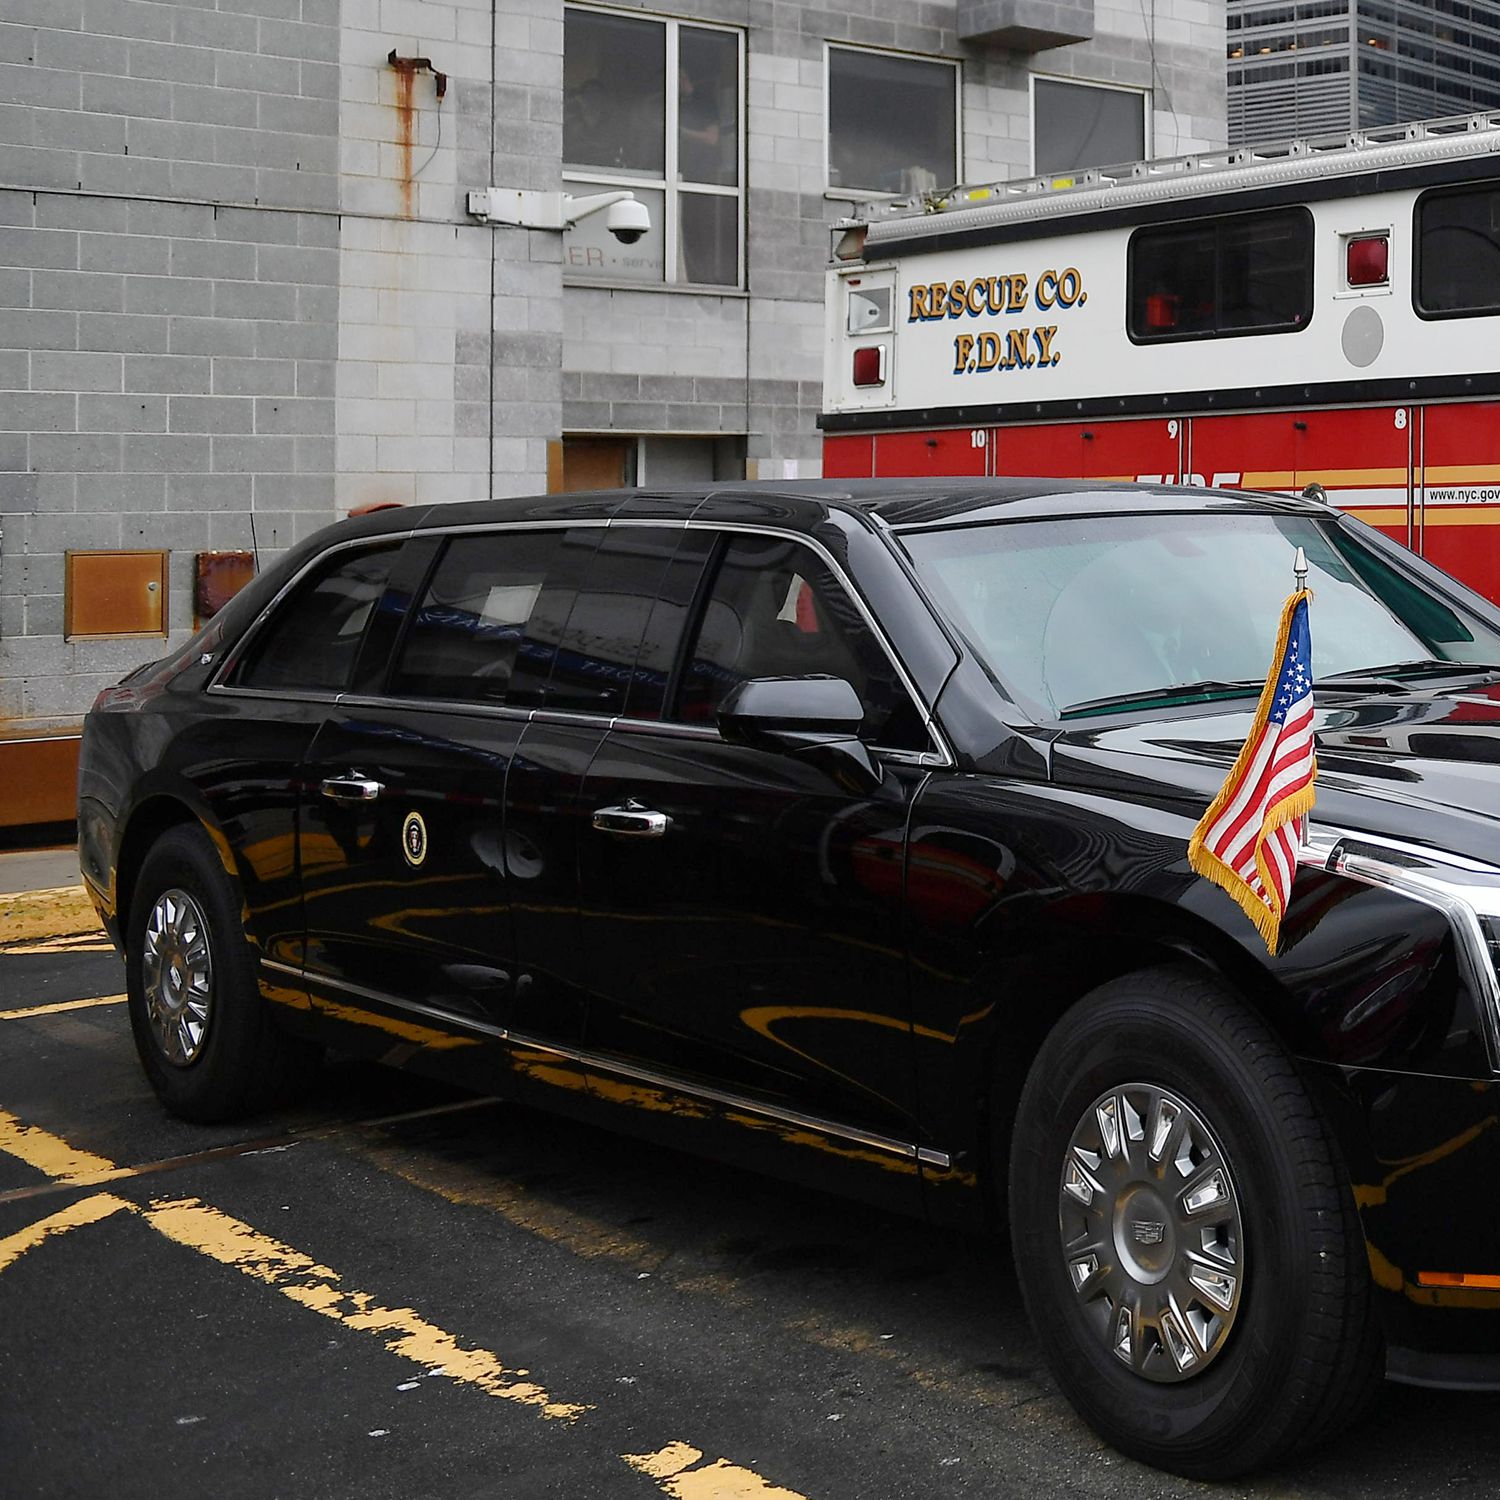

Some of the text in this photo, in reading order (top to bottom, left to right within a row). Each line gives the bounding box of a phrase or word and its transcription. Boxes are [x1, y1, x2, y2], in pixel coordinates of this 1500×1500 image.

[563, 246, 604, 267] ER
[908, 267, 1088, 323] RESCUE CO.
[953, 326, 1061, 375] F.D.N.Y.
[1167, 420, 1178, 439] 9
[1394, 408, 1407, 430] 8
[971, 430, 985, 447] 10
